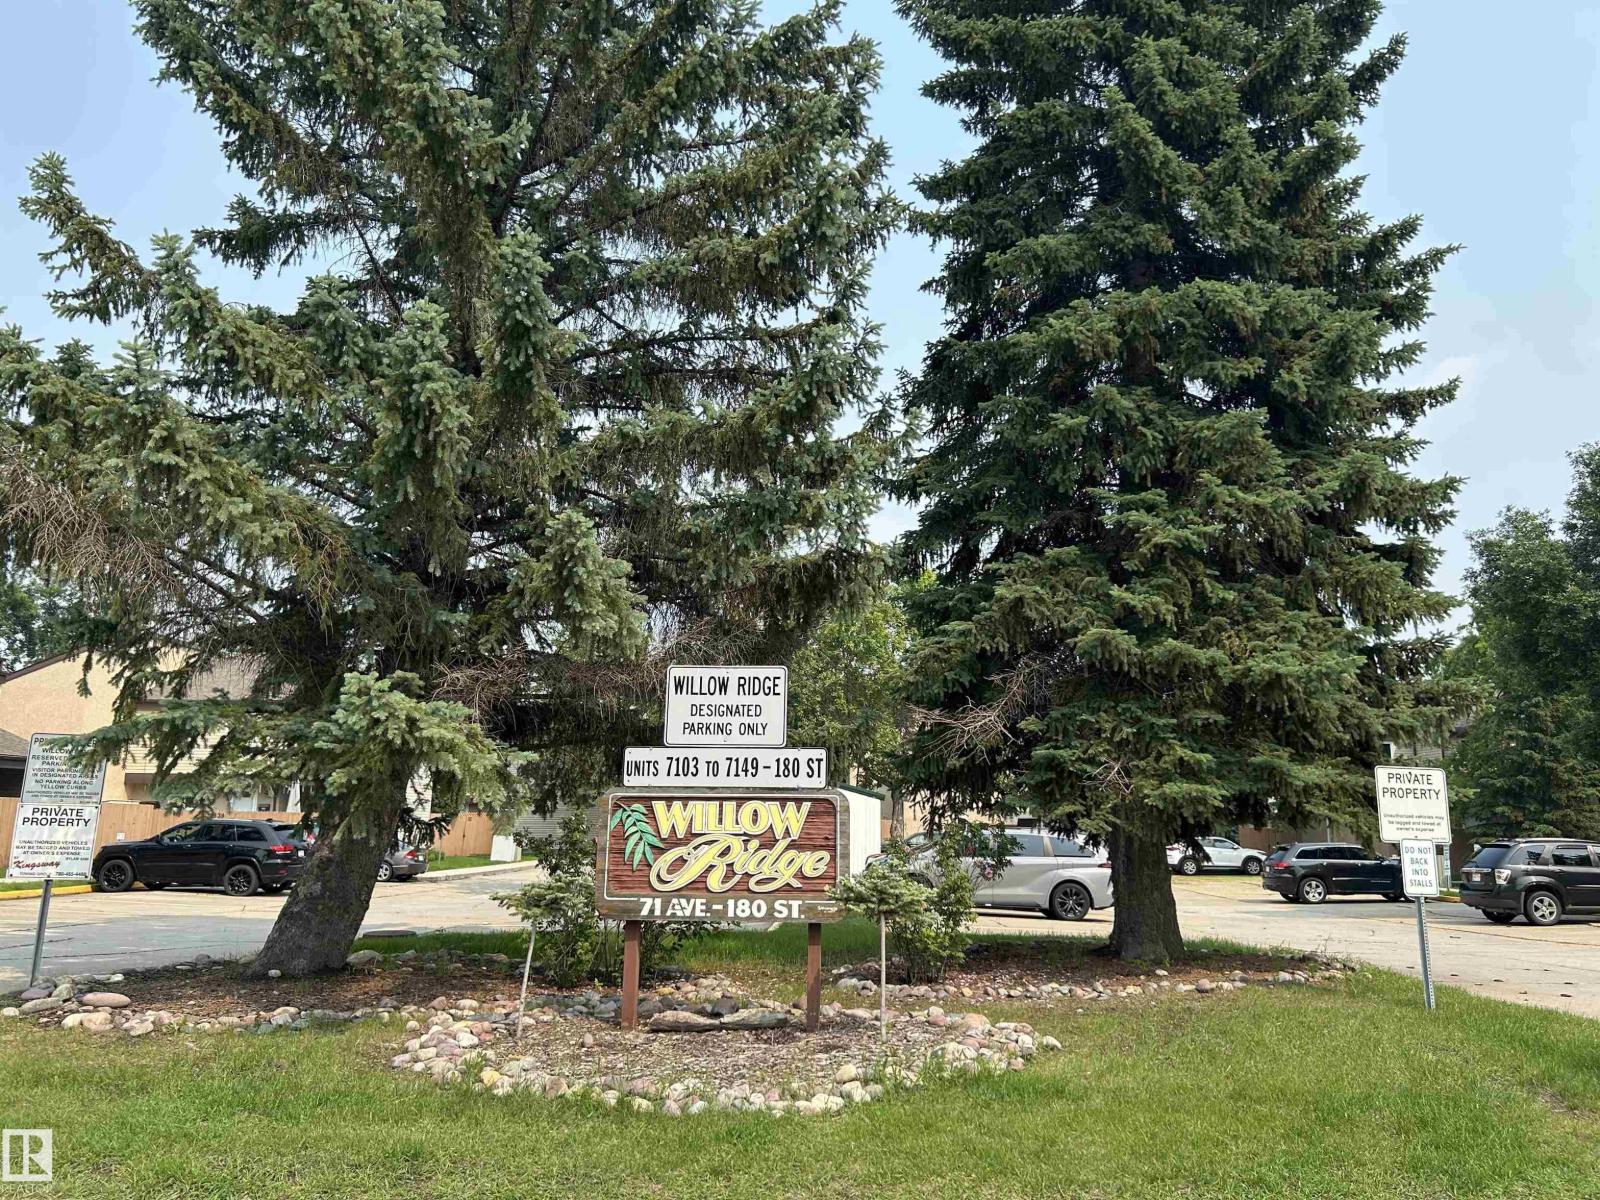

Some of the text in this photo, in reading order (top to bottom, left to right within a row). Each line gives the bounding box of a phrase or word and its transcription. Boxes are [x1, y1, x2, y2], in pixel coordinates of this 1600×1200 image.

[673, 675, 781, 697] WILLOW RIDGE
[690, 703, 762, 718] DESIGNATED
[682, 722, 768, 736] PARKING ONLY
[626, 760, 659, 777] UNITS
[665, 756, 699, 778] 7103
[705, 760, 719, 777] TO
[725, 756, 759, 778] 7149
[774, 757, 800, 778] 180
[806, 757, 823, 779] ST
[1387, 772, 1433, 785] PRIVATE
[1382, 787, 1441, 800] PROPERTY
[31, 807, 84, 817] PRIVATE
[22, 816, 91, 827] PROPERTY
[651, 800, 812, 840] WILLOW
[1404, 846, 1431, 855] DO NOT
[13, 860, 61, 871] Kingsway
[649, 833, 831, 893] Ridge
[1410, 857, 1429, 865] BACK
[1411, 868, 1429, 876] INTO
[1409, 879, 1433, 888] STALLS
[639, 897, 662, 916] 71
[774, 900, 805, 919] ST.
